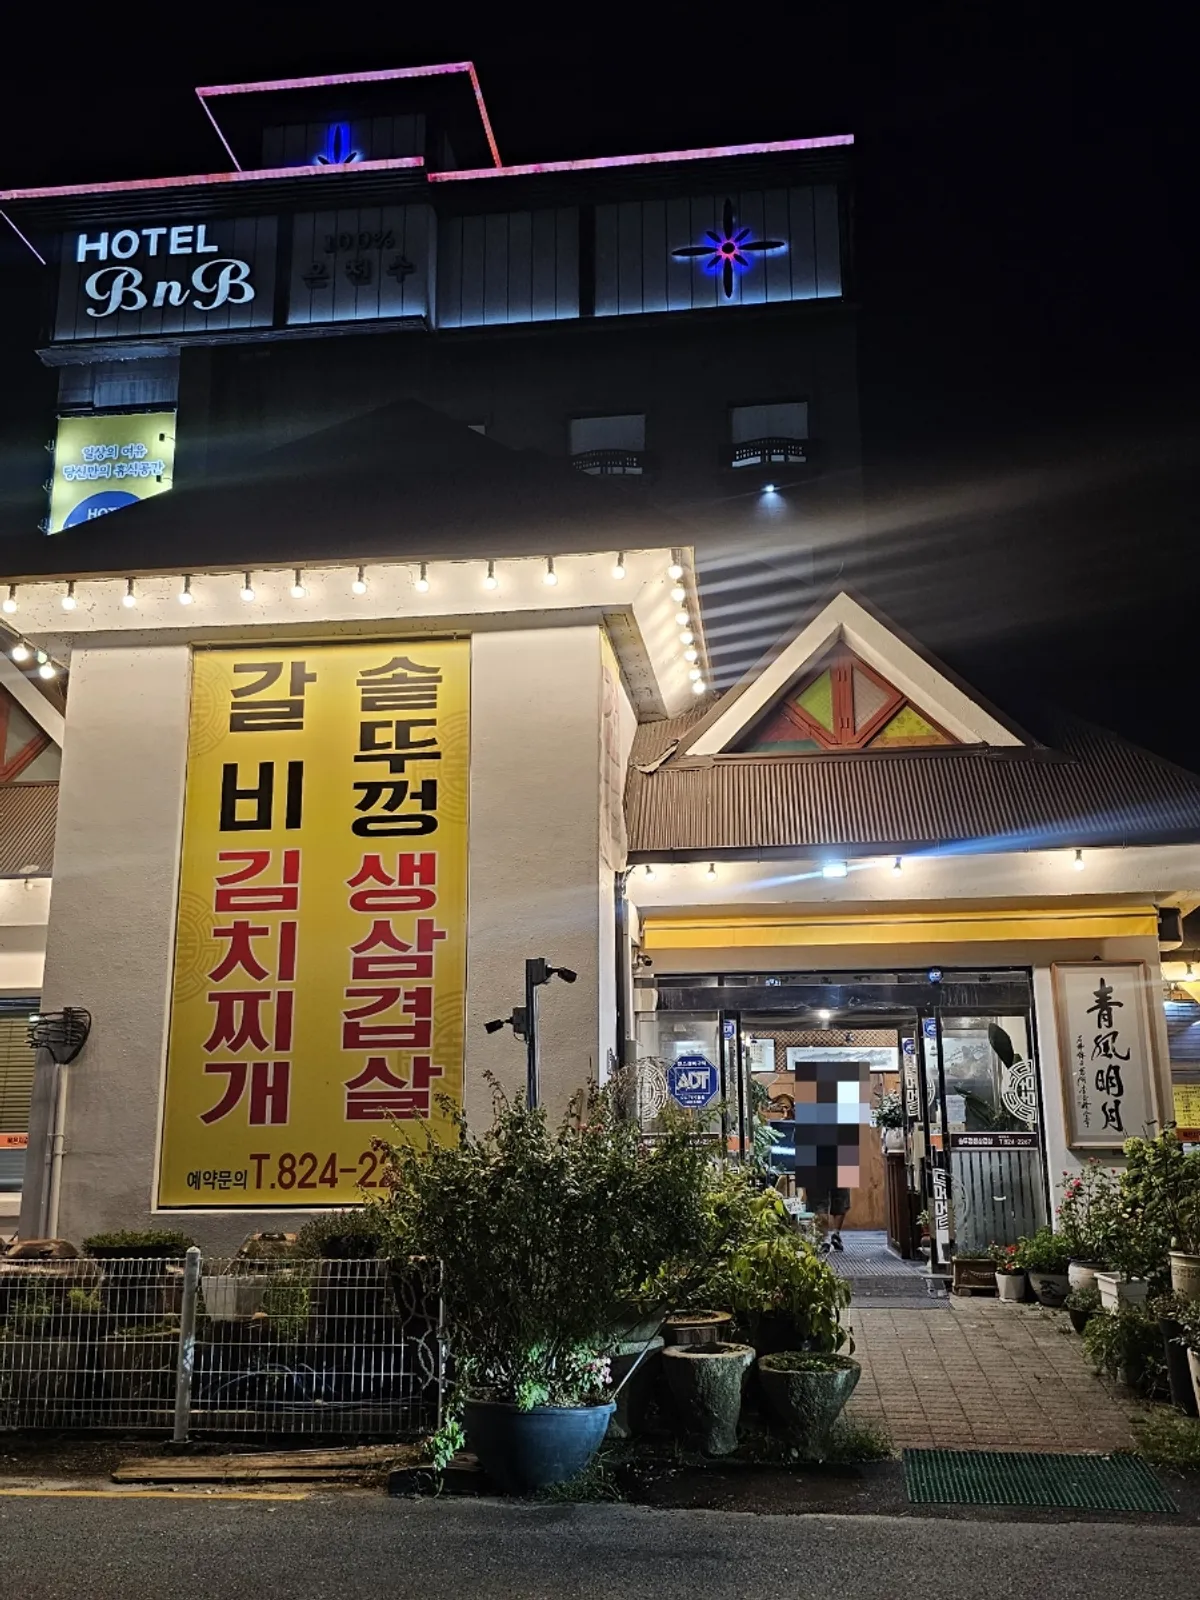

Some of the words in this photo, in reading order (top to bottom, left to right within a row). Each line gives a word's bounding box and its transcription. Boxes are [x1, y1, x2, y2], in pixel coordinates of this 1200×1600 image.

[77, 225, 218, 262] HOTEL
[323, 229, 397, 254] 100%
[84, 258, 256, 318] BnB
[82, 446, 118, 460] 일상의
[121, 443, 148, 459] 여유
[62, 464, 112, 480] 당신만의
[113, 461, 165, 477] 휴식공간
[219, 661, 316, 832] 갈비
[200, 850, 300, 1126] 김치찌개
[677, 1070, 710, 1091] ADT
[186, 1170, 248, 1191] 예약문의
